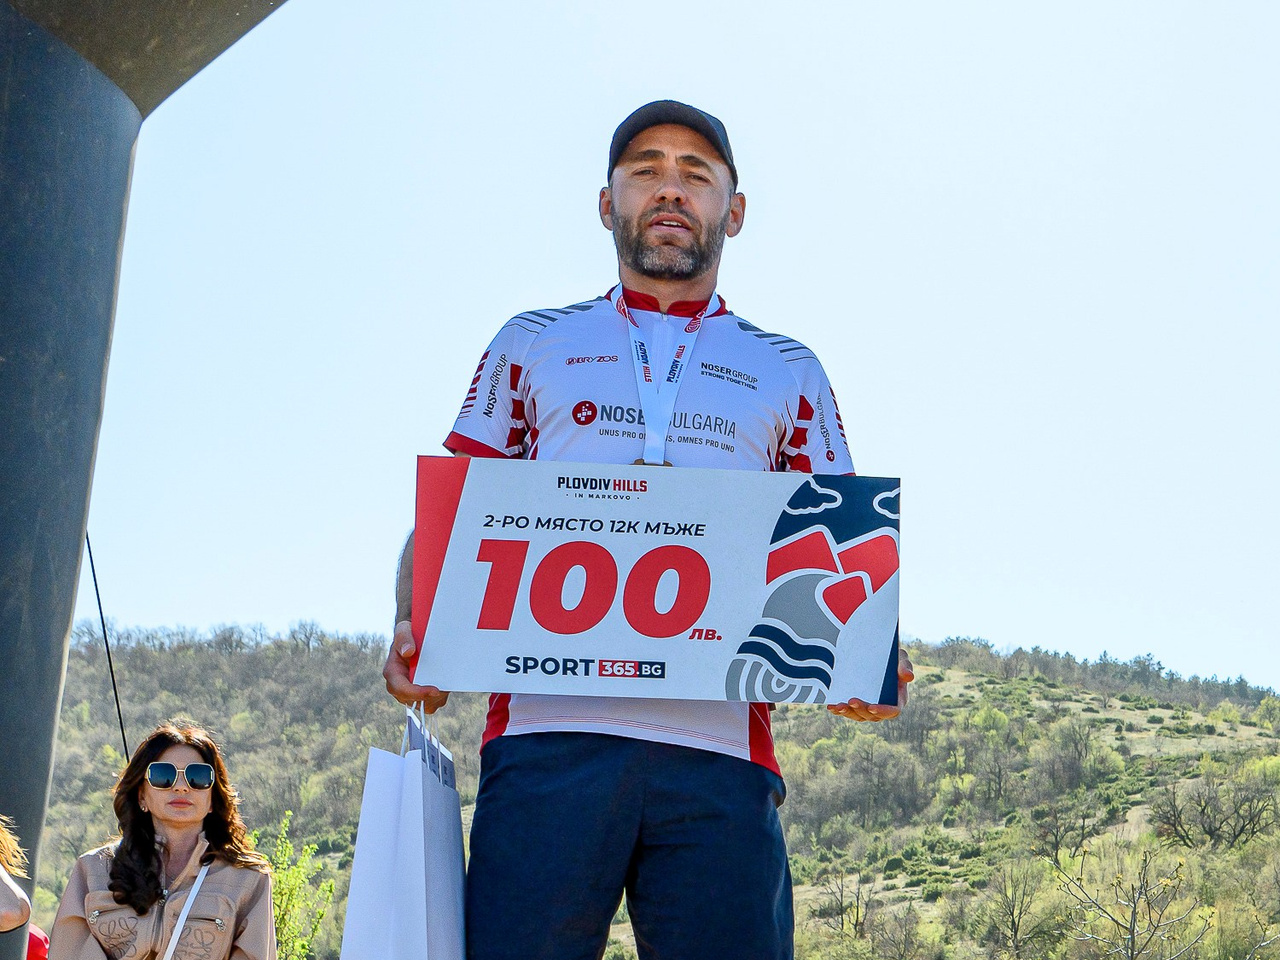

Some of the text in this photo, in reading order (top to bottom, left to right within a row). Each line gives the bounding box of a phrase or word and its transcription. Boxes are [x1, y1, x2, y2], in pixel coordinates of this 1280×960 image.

[701, 362, 758, 384] NOSERGROUP
[701, 371, 758, 392] STRONG TOGETHER!
[599, 429, 620, 437] UNUS
[622, 431, 637, 439] PRO
[677, 435, 704, 445] OMNES
[705, 439, 719, 448] PRO
[720, 443, 735, 453] UNO
[557, 476, 648, 493] PLOVDIV HILLS
[588, 493, 632, 501] MARKOVO
[482, 514, 707, 537] 2-РО МЯСТО 12К МЪЖЕ
[475, 539, 712, 639] 100
[505, 656, 664, 678] SPORT 365.BG
